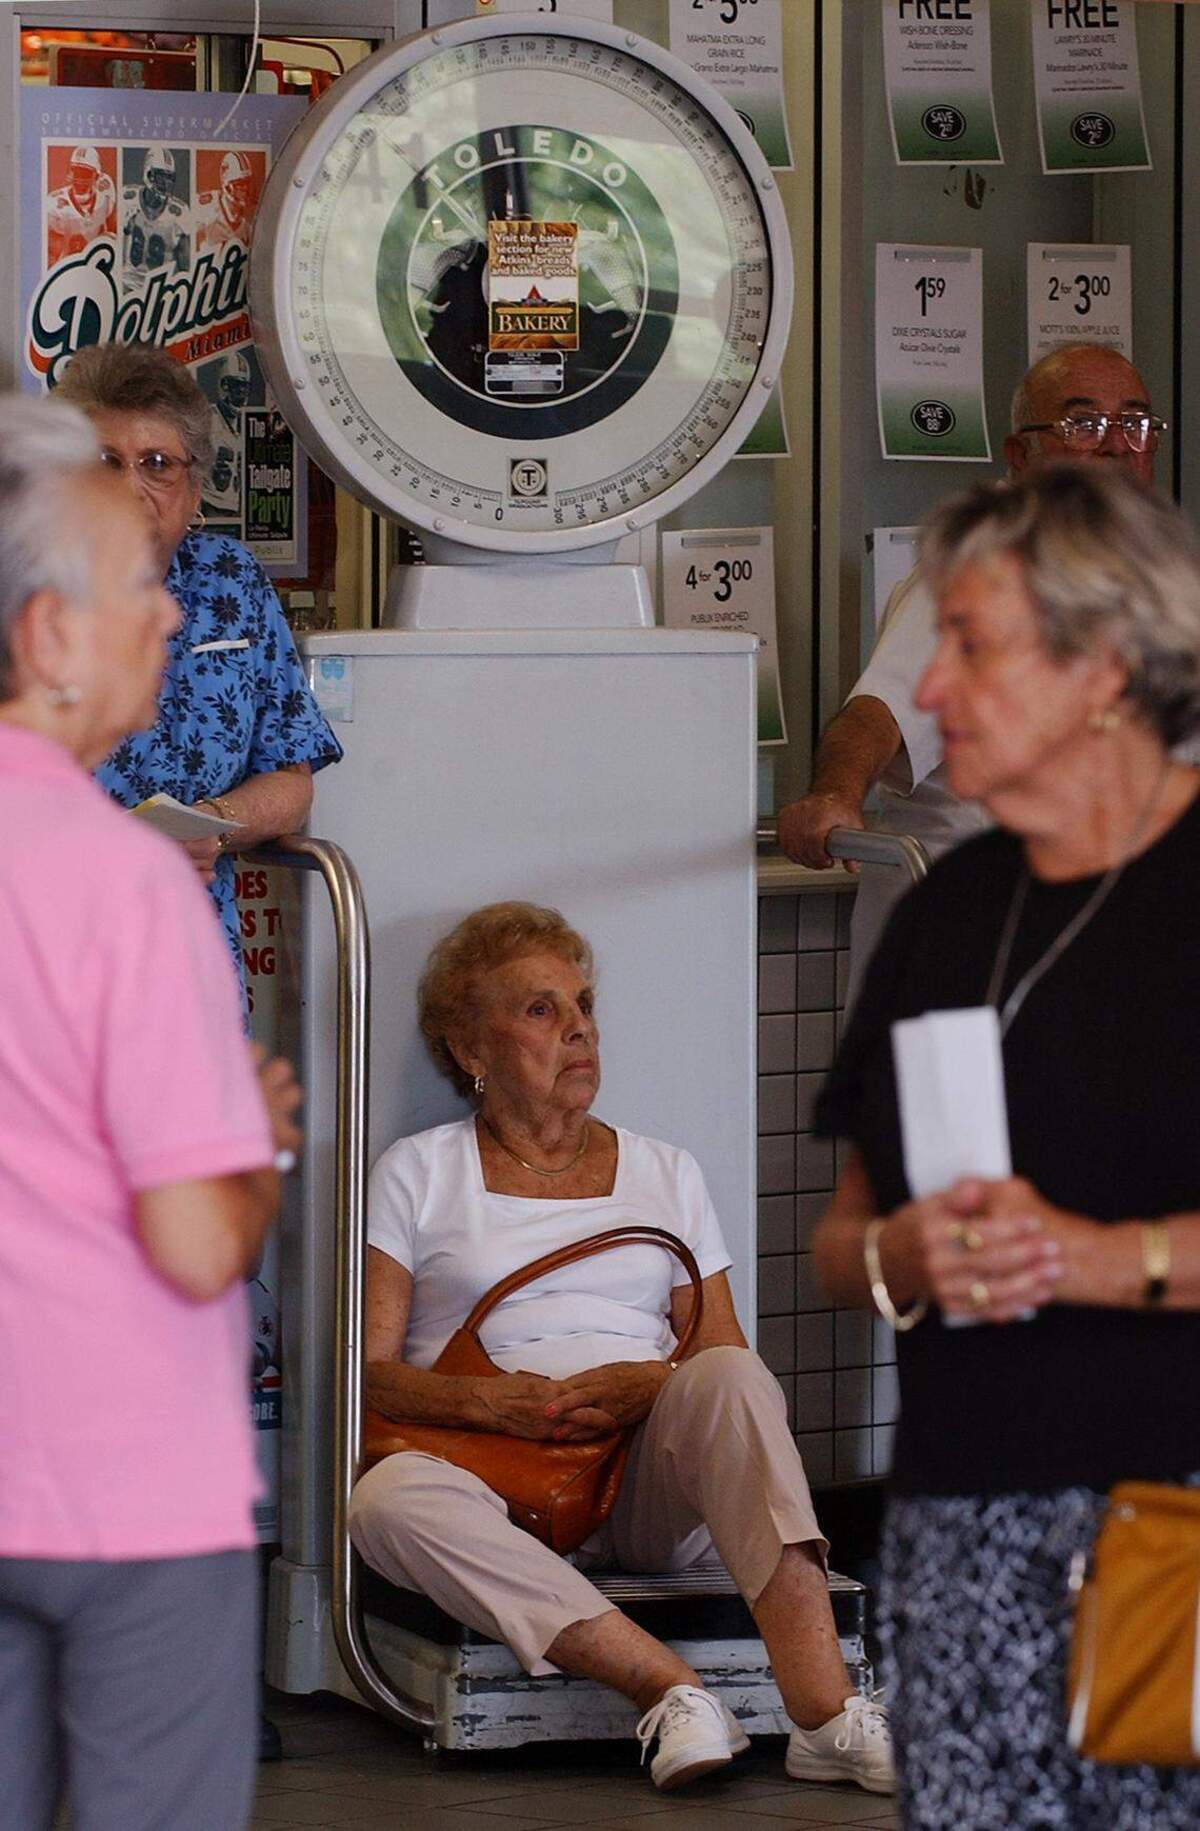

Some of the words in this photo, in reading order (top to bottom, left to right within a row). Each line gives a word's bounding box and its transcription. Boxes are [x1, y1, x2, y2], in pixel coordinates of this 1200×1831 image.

[1047, 0, 1119, 29] FREE
[41, 112, 129, 127] OFFICIAL
[931, 111, 955, 123] SAVE
[1079, 118, 1104, 131] SAVE
[421, 130, 627, 188] TOLEDO
[495, 233, 518, 244] Visit
[520, 234, 537, 244] the
[539, 234, 574, 247] bakery
[496, 244, 533, 254] section
[535, 244, 549, 254] for
[536, 255, 571, 266] breads
[491, 266, 511, 276] and
[512, 266, 543, 277] baked
[1048, 276, 1059, 301] 2
[1060, 283, 1072, 295] for
[499, 314, 571, 333] BAKERY
[919, 406, 944, 419] SAVE
[248, 417, 265, 438] The
[390, 464, 402, 477] 25
[248, 464, 291, 493] Tailgate
[409, 476, 421, 489] 20
[430, 488, 441, 500] 15
[451, 496, 461, 507] 10
[249, 491, 291, 529] Party
[495, 507, 504, 521] 0
[685, 564, 697, 590] 4
[699, 570, 711, 582] for
